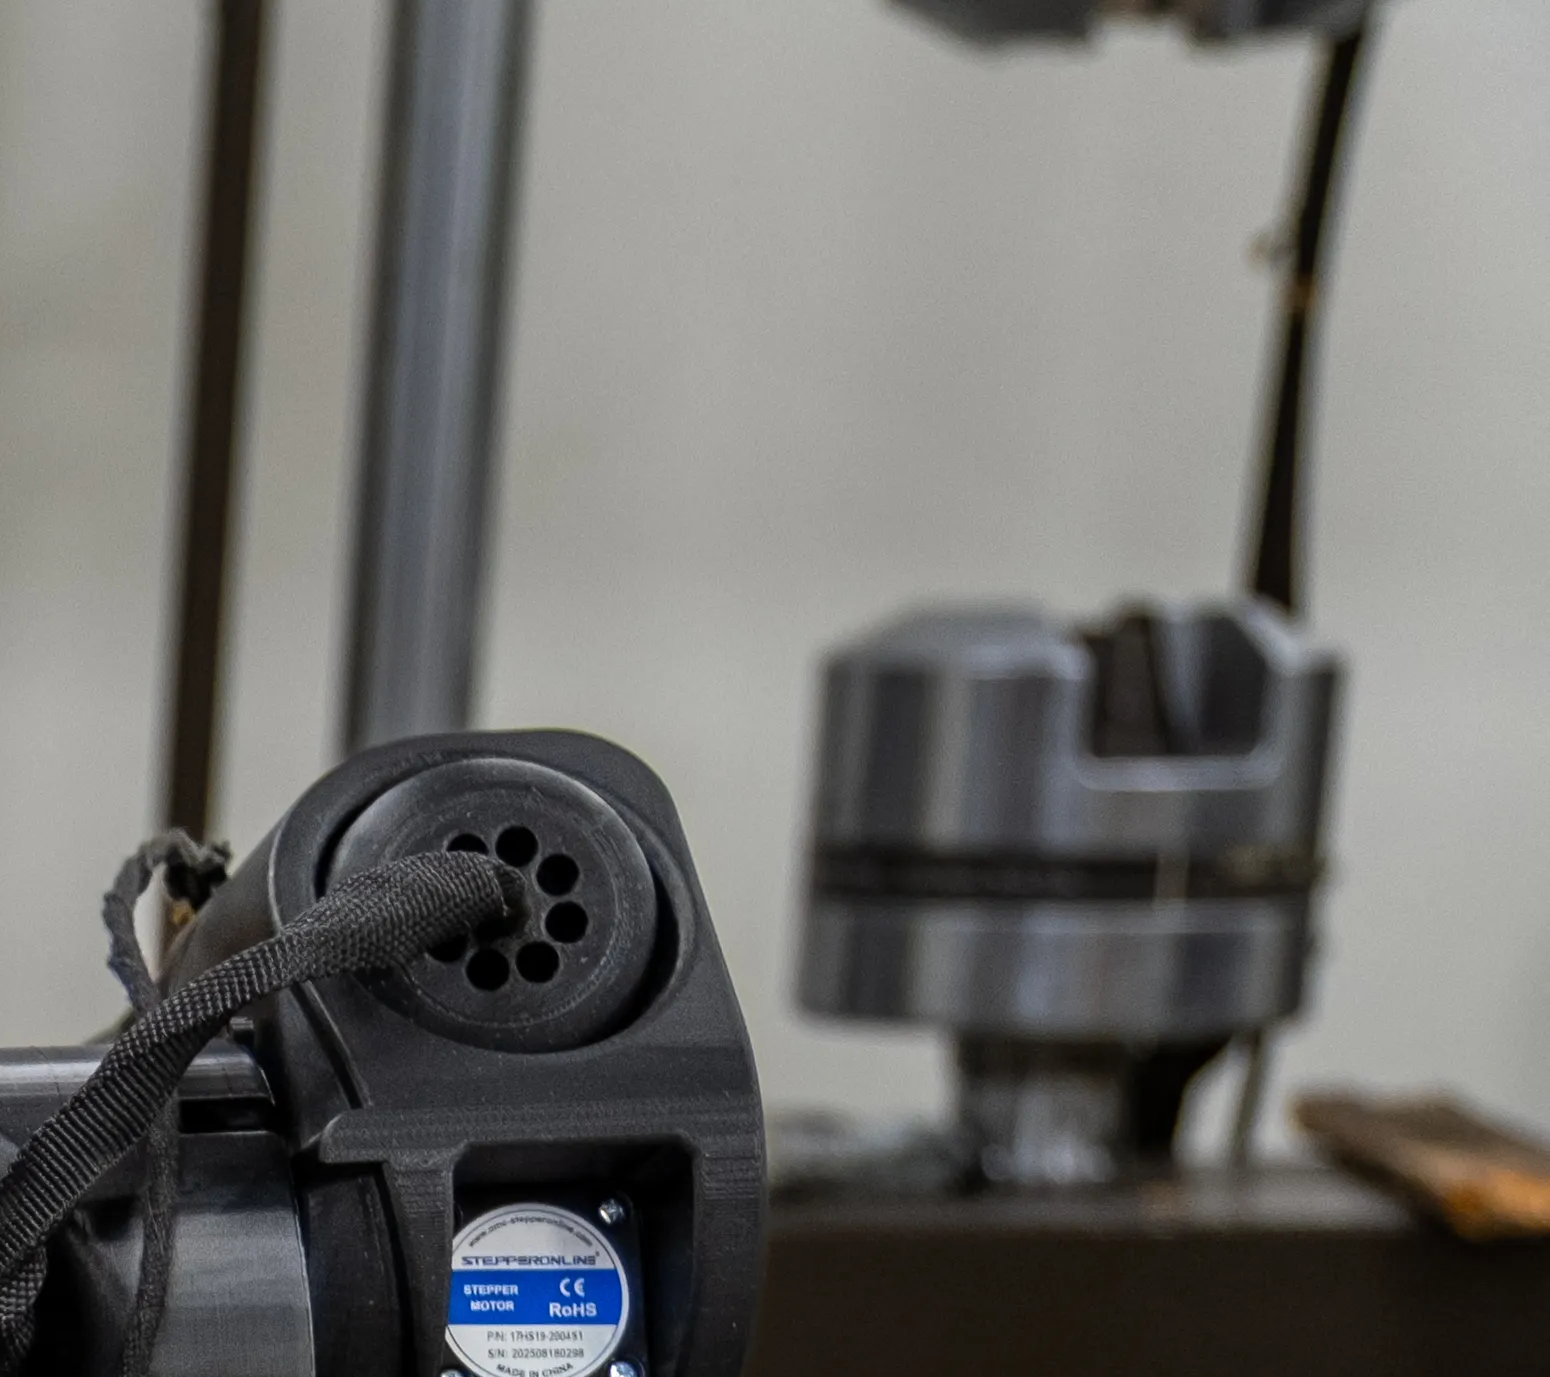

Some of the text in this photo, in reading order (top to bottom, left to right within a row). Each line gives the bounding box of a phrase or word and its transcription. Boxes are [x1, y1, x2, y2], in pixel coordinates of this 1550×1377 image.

[462, 1255, 596, 1267] STEPPERONLINE
[463, 1284, 519, 1297] STEPPER
[470, 1299, 515, 1312] MOTOR
[549, 1302, 598, 1317] RoHS
[496, 1362, 526, 1377] MADE
[542, 1362, 574, 1377] CHINA
